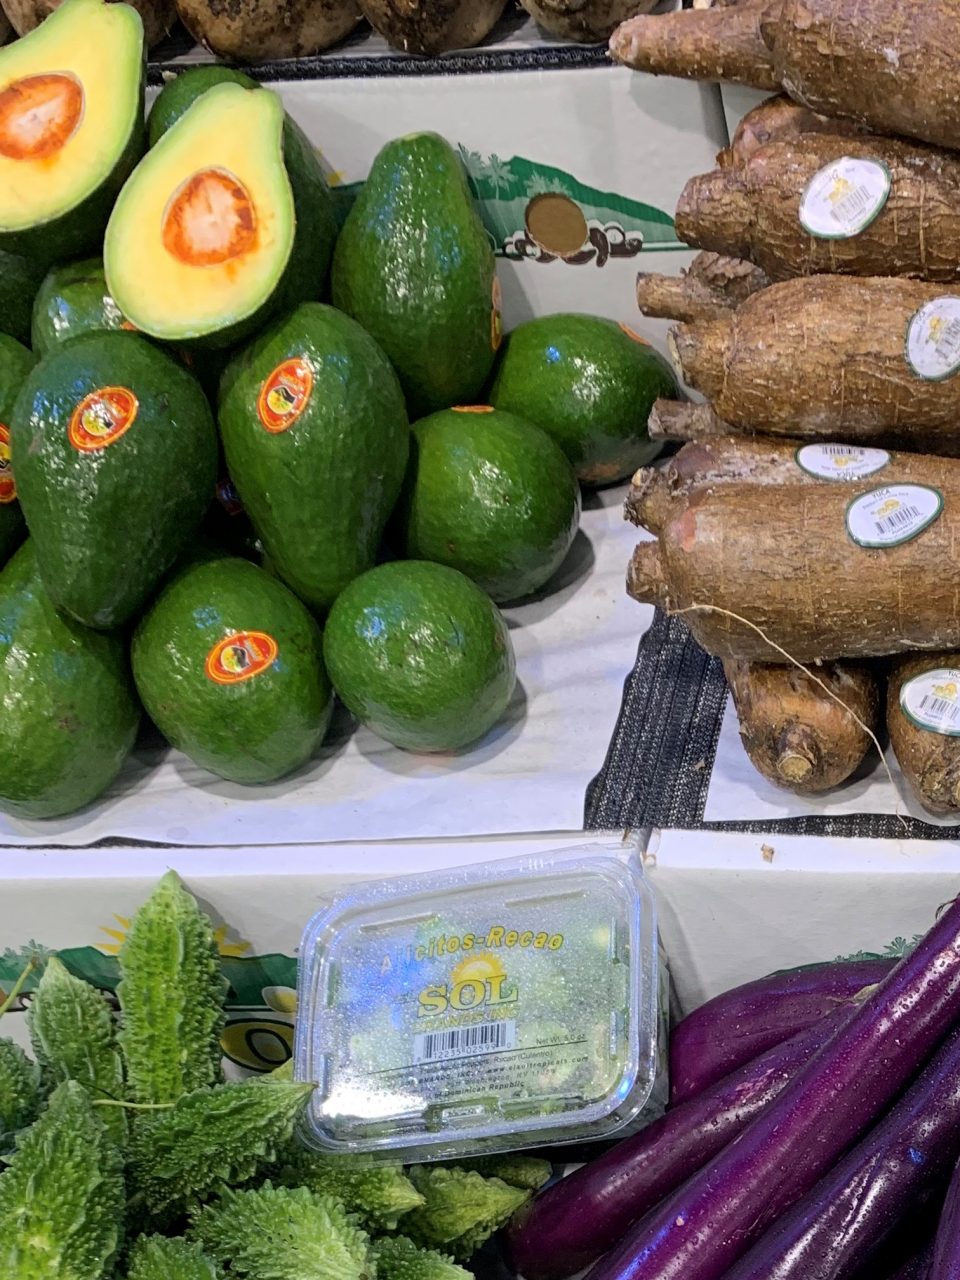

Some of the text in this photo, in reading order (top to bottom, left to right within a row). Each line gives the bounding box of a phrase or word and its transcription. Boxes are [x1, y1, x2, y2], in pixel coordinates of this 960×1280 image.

[417, 974, 519, 1018] SOL
[466, 1041, 497, 1055] 02599
[489, 1081, 525, 1092] Republic
